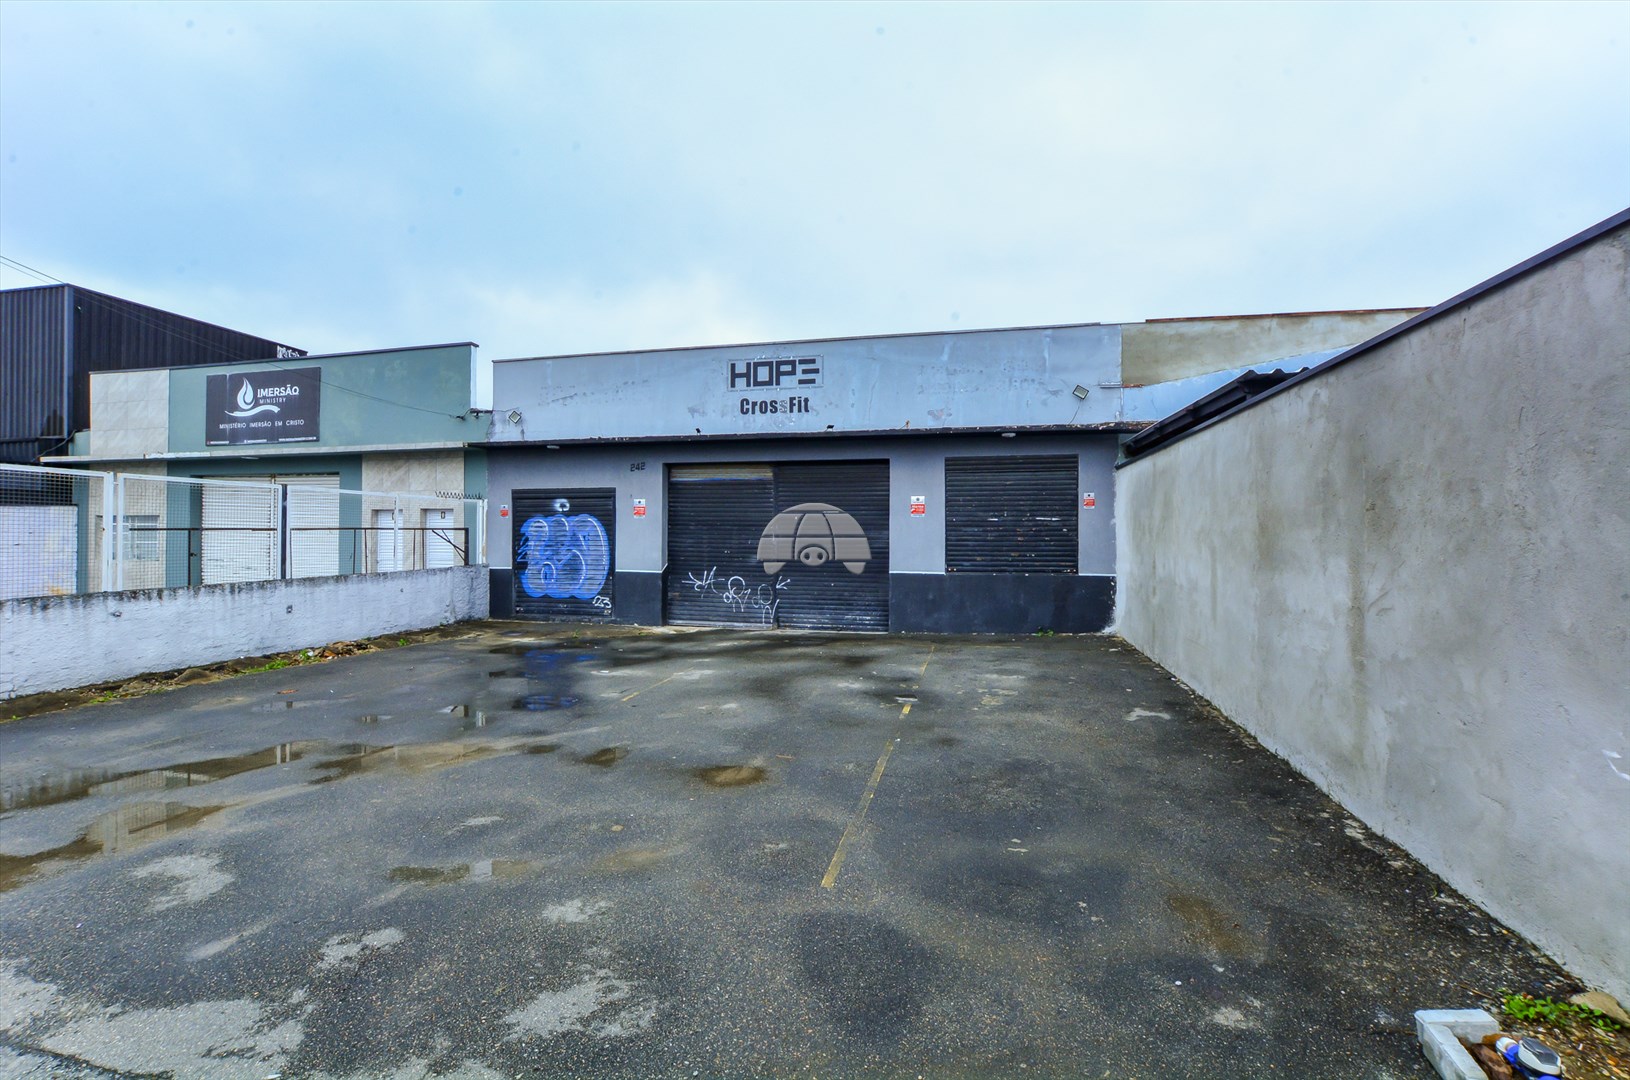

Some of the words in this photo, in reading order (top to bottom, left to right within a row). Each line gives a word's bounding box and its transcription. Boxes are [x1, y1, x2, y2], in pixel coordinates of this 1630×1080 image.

[730, 358, 820, 388] HOPE
[257, 384, 300, 397] IMERSÃO
[740, 396, 810, 415] CrossFit
[249, 420, 272, 428] IMERSÃO
[630, 462, 645, 472] 242
